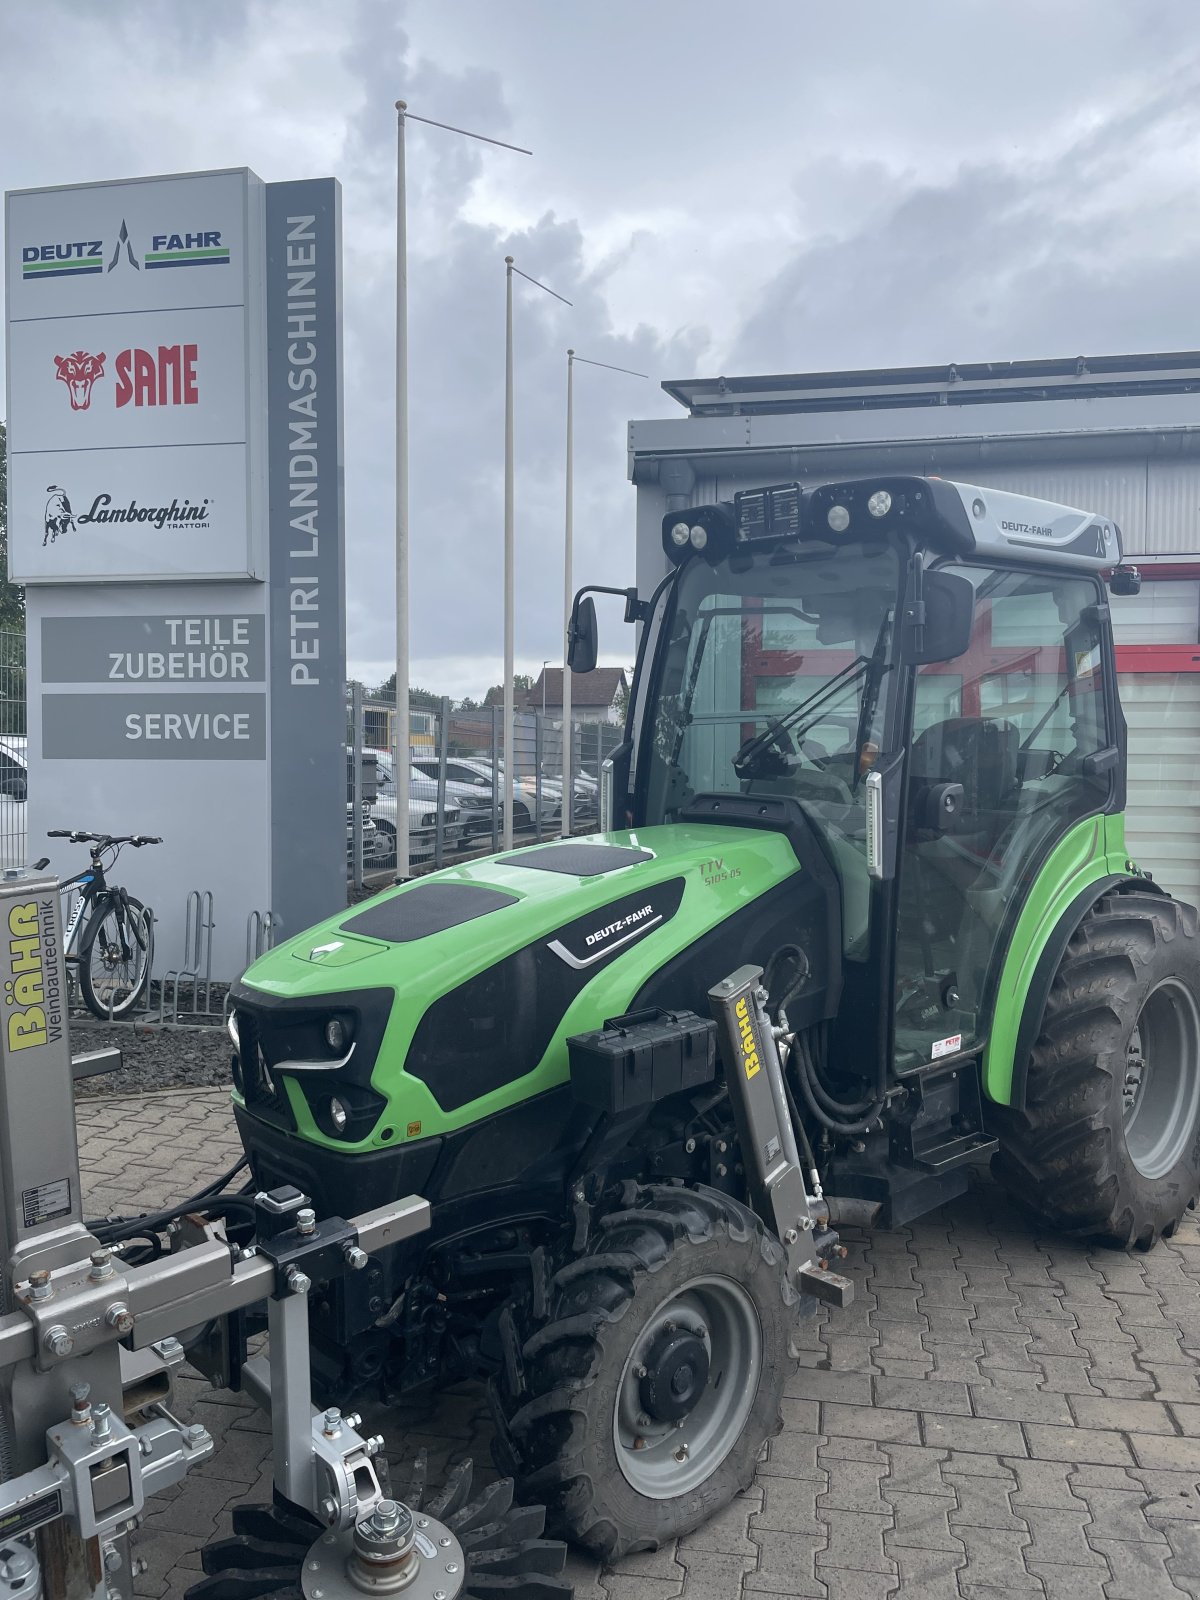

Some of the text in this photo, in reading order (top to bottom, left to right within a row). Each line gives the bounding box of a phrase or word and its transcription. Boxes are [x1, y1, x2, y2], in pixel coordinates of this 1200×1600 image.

[23, 231, 222, 262] DEUTZ FAHR
[115, 344, 199, 408] SAME
[287, 214, 319, 685] PETRI LANDMASCHINEN
[78, 493, 210, 530] Lamborghini
[1001, 520, 1053, 537] DEUTZ-FAHR
[165, 618, 250, 646] TEILE
[108, 645, 249, 679] ZUBEHÖR
[125, 713, 250, 740] SERVICE
[699, 858, 723, 876] TTV
[704, 871, 728, 887] 5105
[66, 897, 84, 933] CROSS
[585, 904, 654, 946] DEUTZ-FAHR
[4, 901, 48, 1053] BÄHR
[40, 899, 63, 1043] Weinbautechnik
[735, 997, 761, 1081] BÄHR
